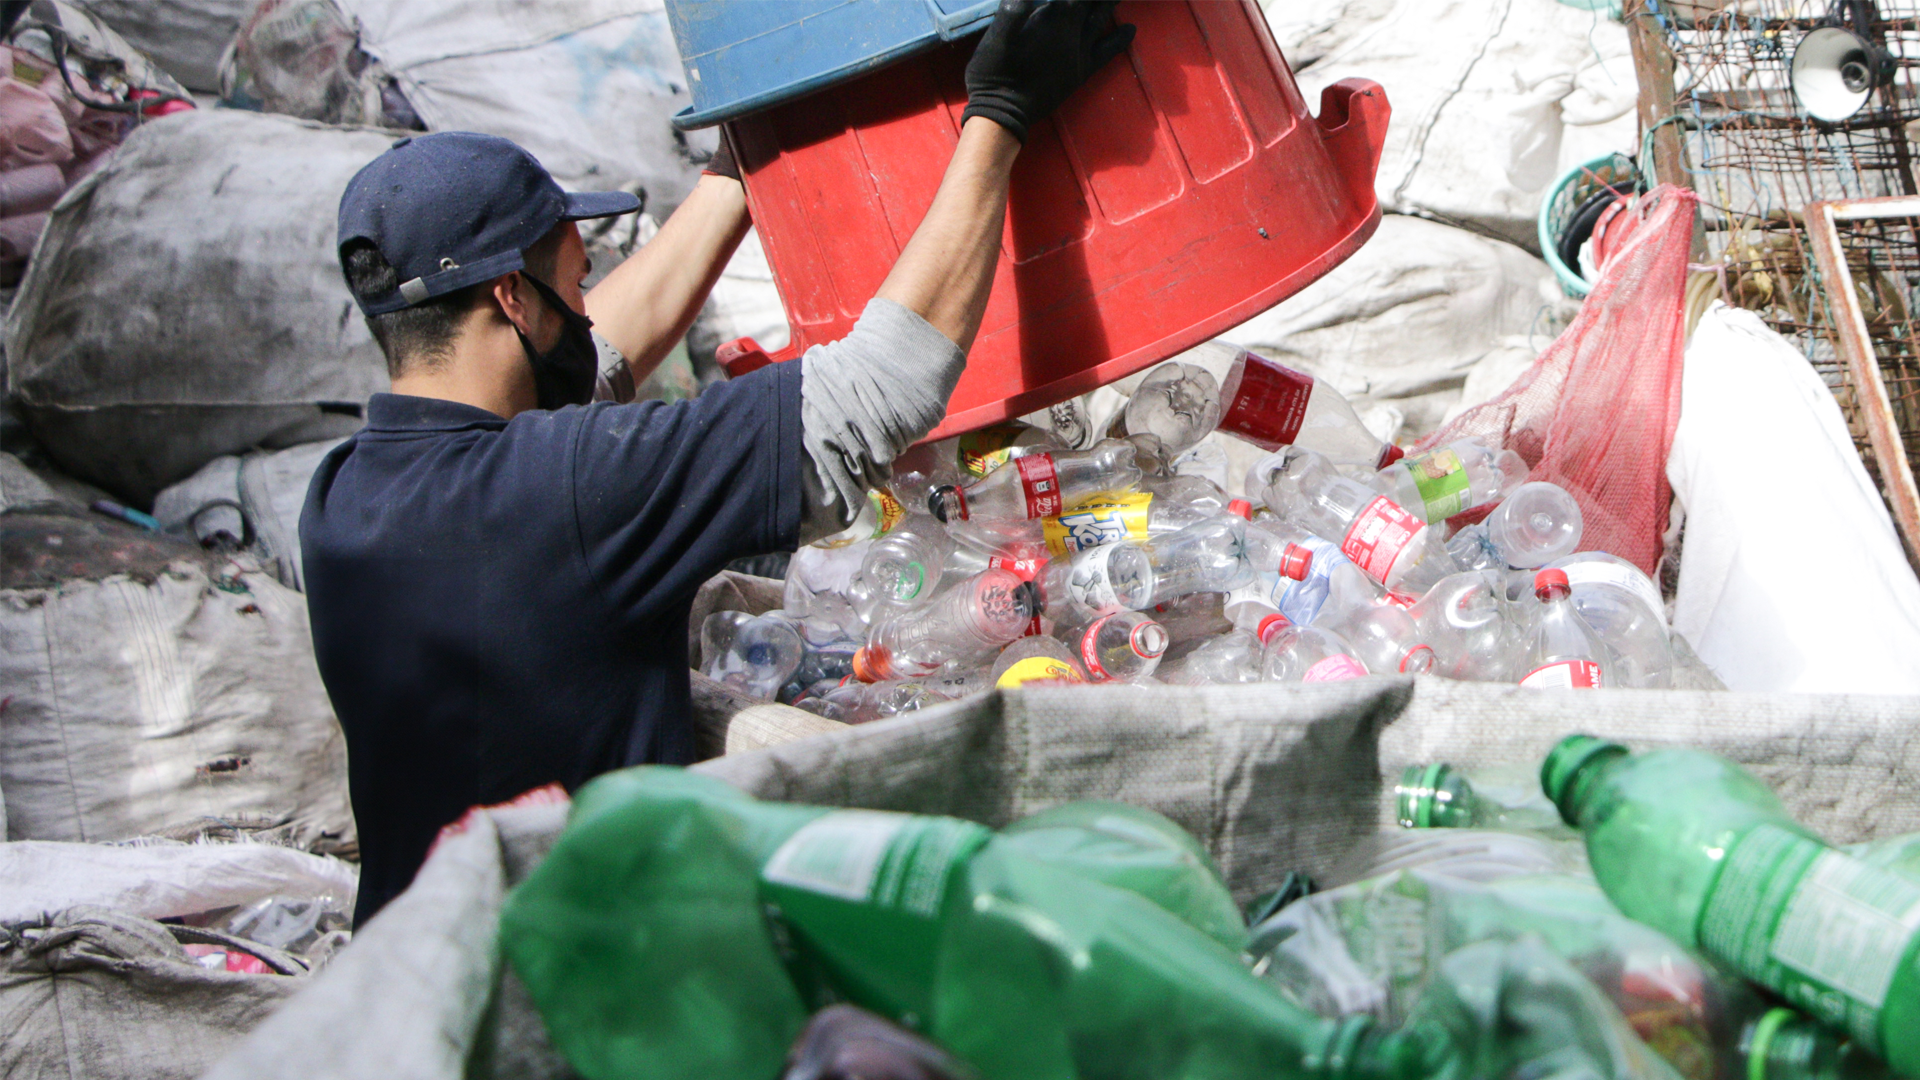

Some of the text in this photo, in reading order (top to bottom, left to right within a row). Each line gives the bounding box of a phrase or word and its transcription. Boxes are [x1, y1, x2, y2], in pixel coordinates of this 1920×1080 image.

[1059, 512, 1103, 549] KO
[1090, 511, 1127, 545] TR
[1589, 664, 1600, 690] AME
